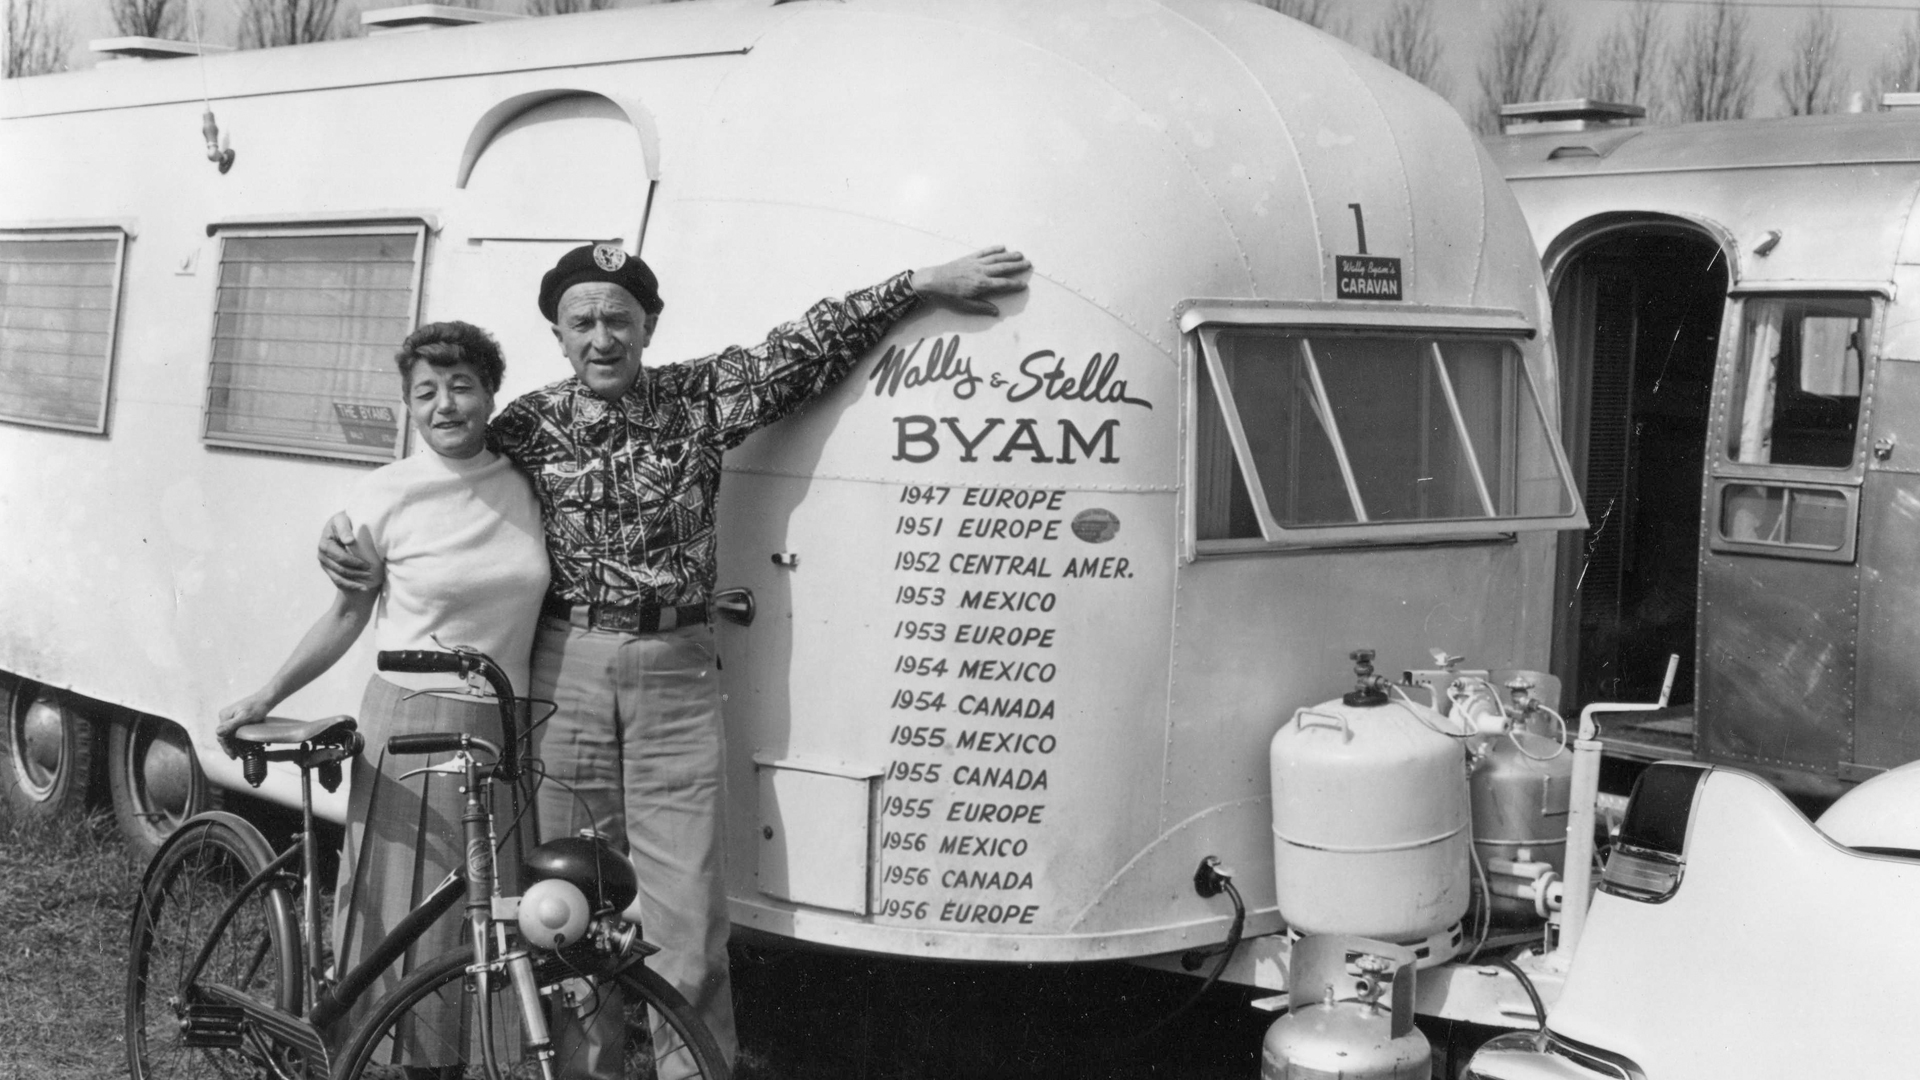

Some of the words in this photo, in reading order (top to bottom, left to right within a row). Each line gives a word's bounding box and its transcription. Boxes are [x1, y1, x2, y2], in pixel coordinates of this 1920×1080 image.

[1347, 203, 1368, 254] 1
[1341, 278, 1398, 294] CARAVAN
[869, 335, 983, 400] Wally
[989, 372, 1009, 388] &
[1006, 350, 1153, 411] Stella
[892, 415, 1120, 464] BYAM
[900, 486, 950, 504] 1947
[963, 488, 1066, 510] EUROPE
[895, 516, 943, 536] 1951
[958, 518, 1062, 540] EUROPE
[895, 551, 941, 573] 1952
[949, 553, 1052, 578] CENTRAL
[1062, 557, 1134, 578] AMER.
[895, 586, 946, 606] 1953
[960, 590, 1057, 612] MEXICO
[894, 621, 947, 641] 1953
[954, 624, 1056, 647] EUROPE
[894, 655, 949, 677] 1954
[957, 660, 1057, 682] MEXICO
[891, 690, 947, 711] 1954
[957, 695, 1055, 719] CANADA
[890, 725, 947, 747] 1955
[956, 731, 1057, 753] MEXICO
[887, 761, 942, 783] 1955
[953, 766, 1048, 790] CANADA
[883, 797, 934, 818] 1955
[946, 802, 1045, 824] EUROPE
[882, 832, 929, 851] 1956
[938, 836, 1028, 857] MEXICO
[883, 866, 931, 885] 1956
[941, 870, 1033, 889] CANADA
[881, 899, 930, 919] 1956
[939, 902, 1039, 923] EUROPE
